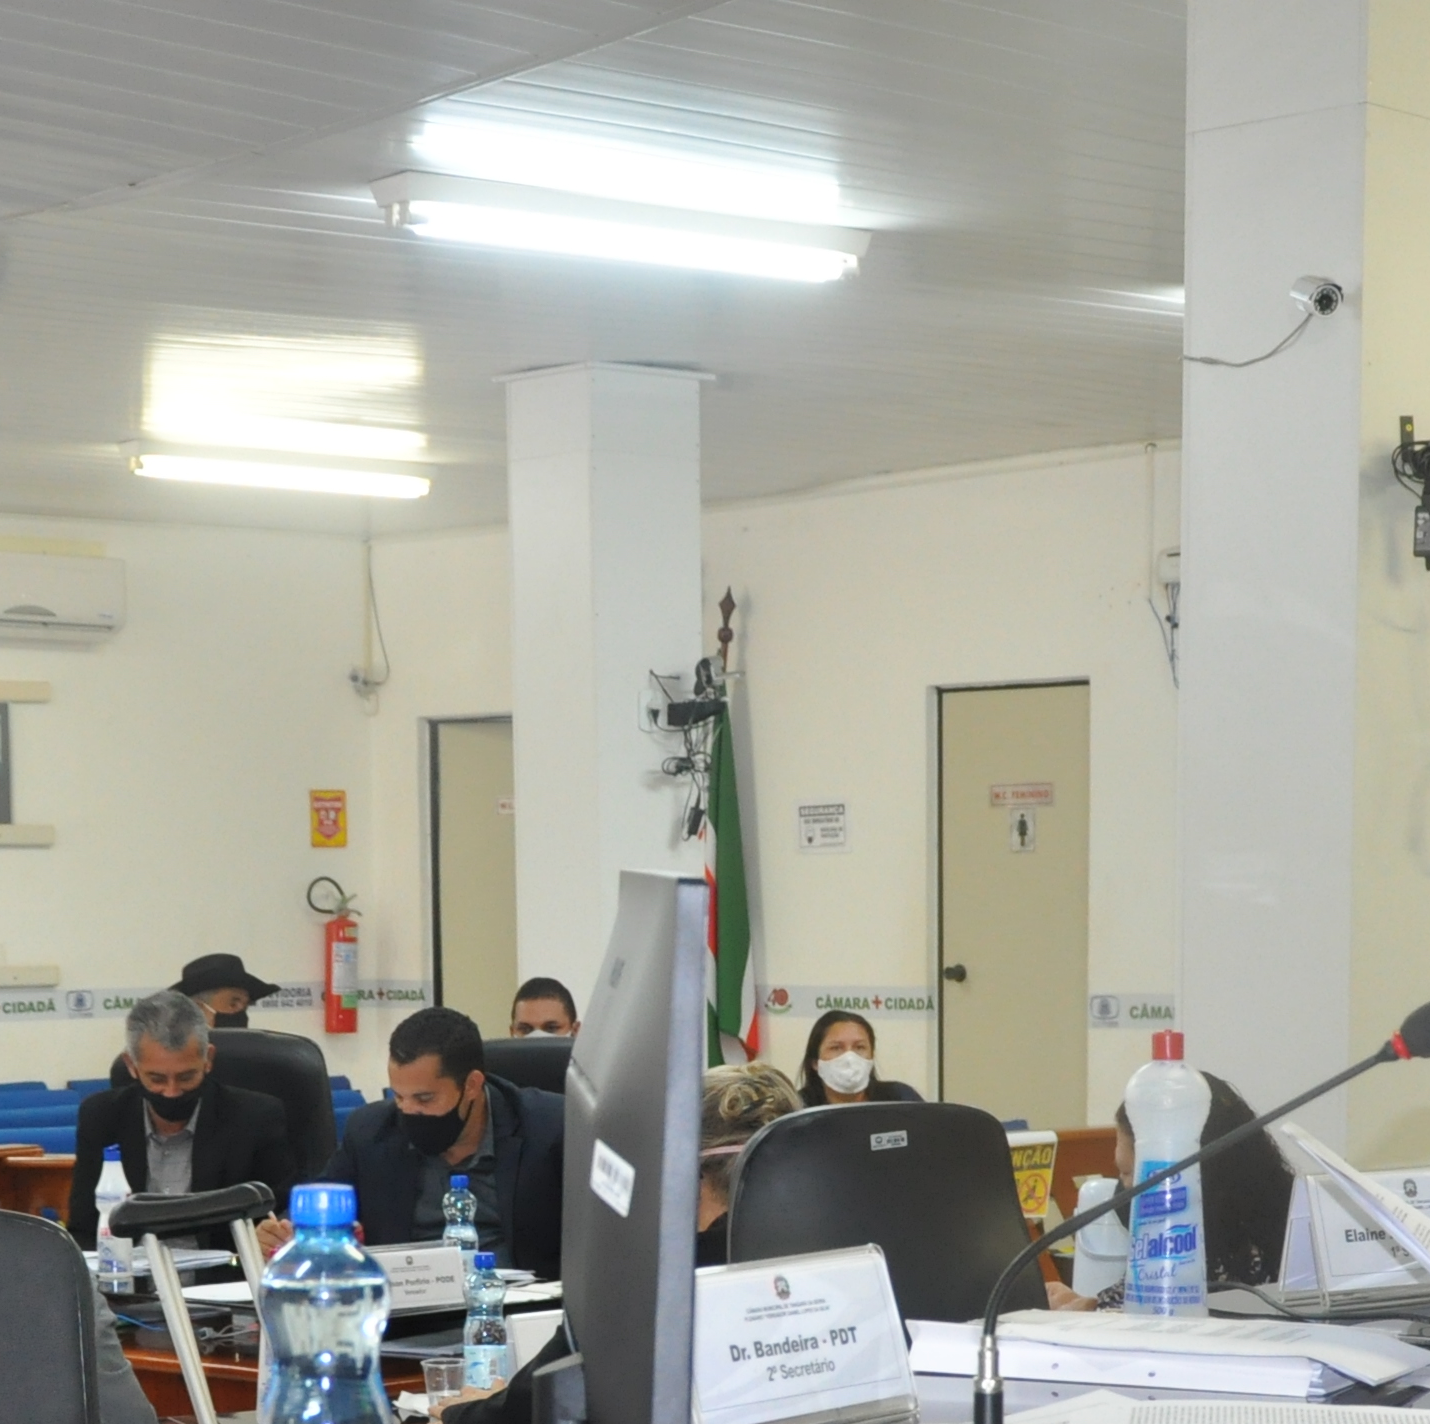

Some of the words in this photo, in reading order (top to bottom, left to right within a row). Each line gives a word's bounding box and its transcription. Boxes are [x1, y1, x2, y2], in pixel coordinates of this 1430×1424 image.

[385, 987, 426, 1002] CIDADÃ
[815, 994, 871, 1011] CÂMARA
[884, 994, 935, 1011] CIDADÃ
[2, 996, 56, 1014] CIDADÃ
[1129, 1003, 1175, 1020] CÂMA
[1344, 1229, 1386, 1244] Elaine
[1137, 1264, 1178, 1281] Cristal
[729, 1344, 752, 1363] Dr.
[753, 1334, 820, 1359] Bandeira
[829, 1326, 858, 1347] PDT
[780, 1358, 836, 1380] Secretário
